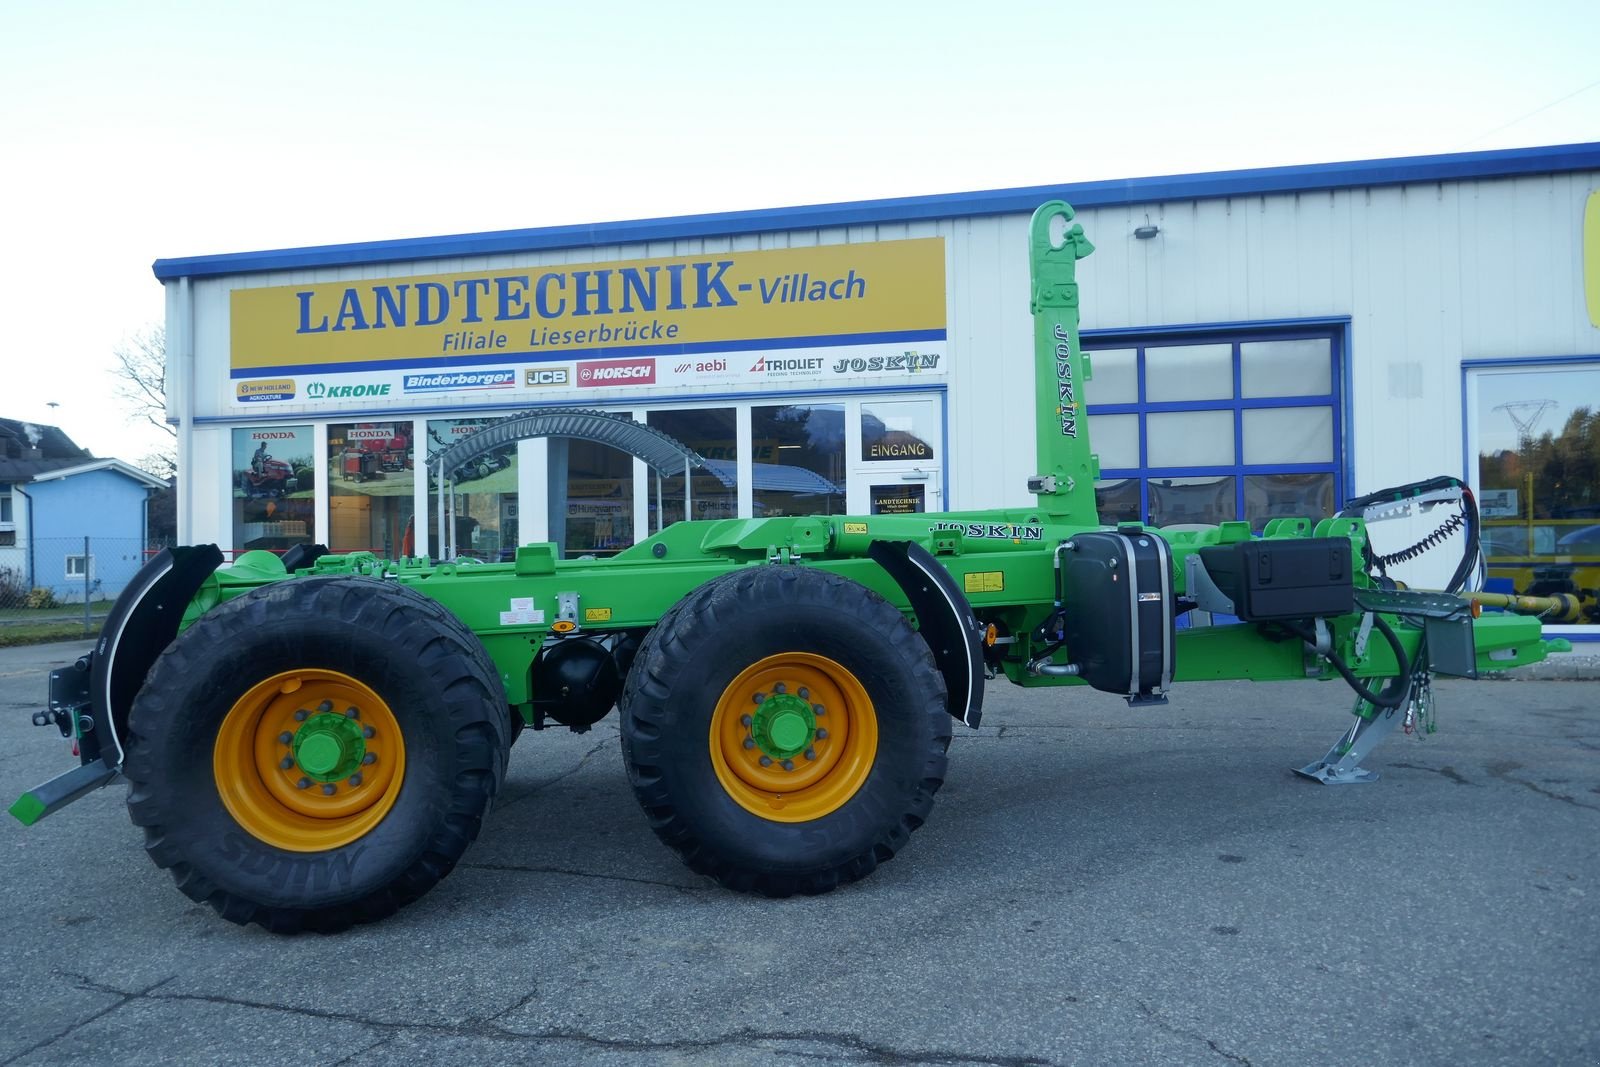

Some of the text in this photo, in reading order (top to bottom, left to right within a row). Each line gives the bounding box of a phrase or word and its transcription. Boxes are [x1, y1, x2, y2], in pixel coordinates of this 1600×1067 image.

[442, 319, 680, 352] Filiale Lieserbrücke
[696, 358, 727, 373] aebi
[765, 357, 825, 371] TRIOLIET
[832, 352, 941, 374] JOSKIN
[406, 370, 514, 388] Binderberger
[527, 369, 568, 384] JCB
[592, 364, 652, 380] HORSCH
[265, 383, 291, 391] HOLLAND
[1053, 322, 1078, 439] JOSKIN
[249, 393, 282, 401] AGRICULTURE
[327, 383, 392, 398] KRONE
[252, 431, 296, 440] HONDA
[350, 430, 393, 439] HONDA
[871, 443, 926, 457] EINGANG
